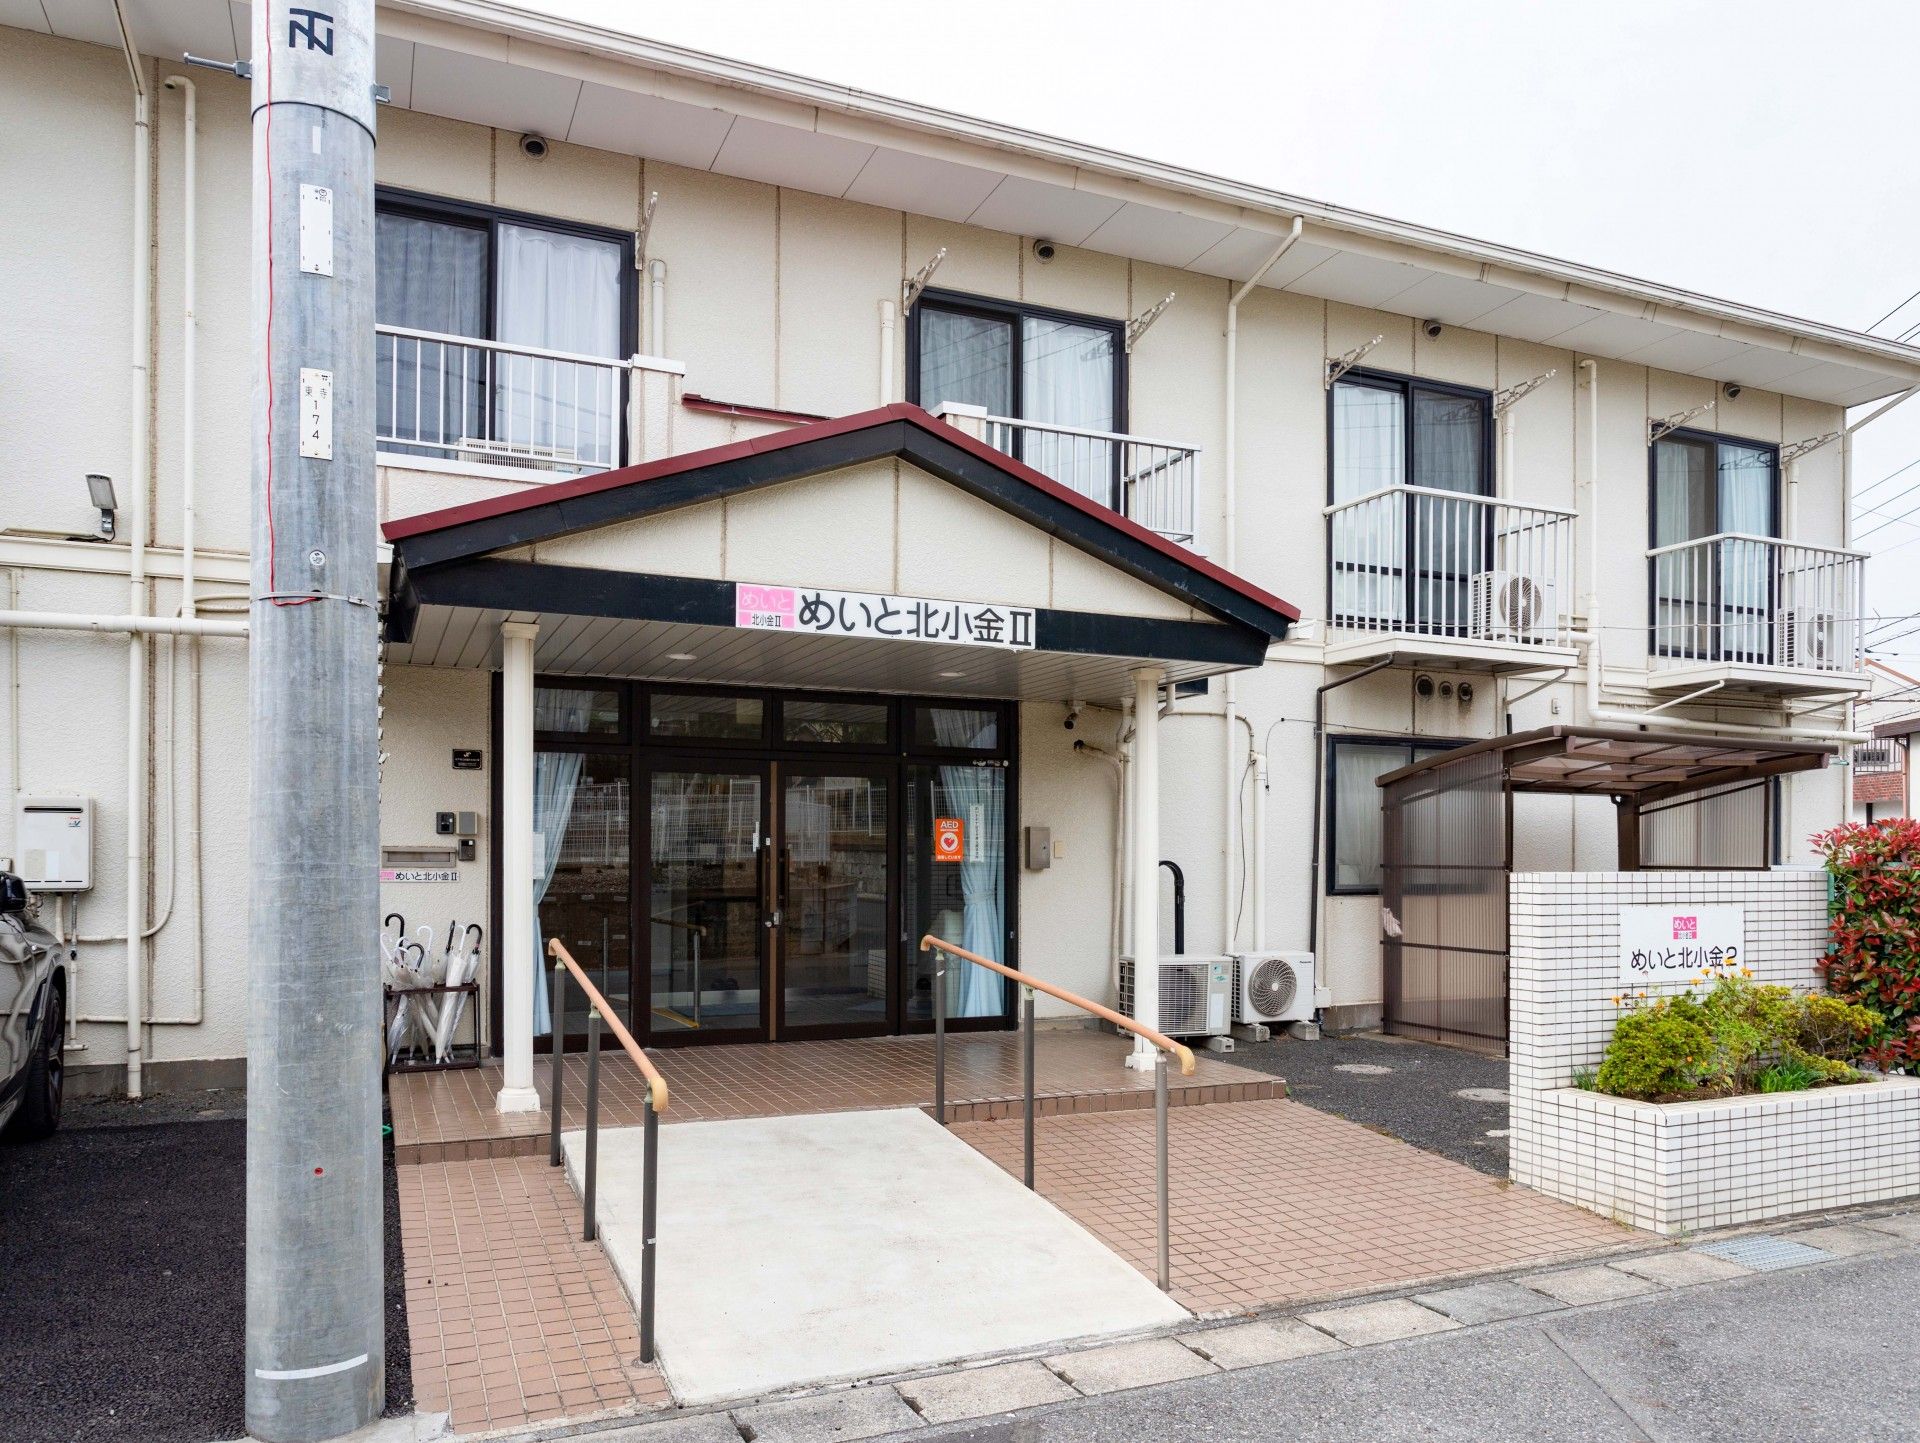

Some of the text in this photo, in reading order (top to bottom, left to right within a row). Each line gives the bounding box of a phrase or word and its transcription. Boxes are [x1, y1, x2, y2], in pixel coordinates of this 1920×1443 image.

[312, 400, 320, 440] 174
[742, 591, 792, 611] めいと
[799, 592, 1032, 646] めいと北小金Ⅱ
[1673, 919, 1697, 930] めいと
[1631, 945, 1738, 970] めいと北小金2
